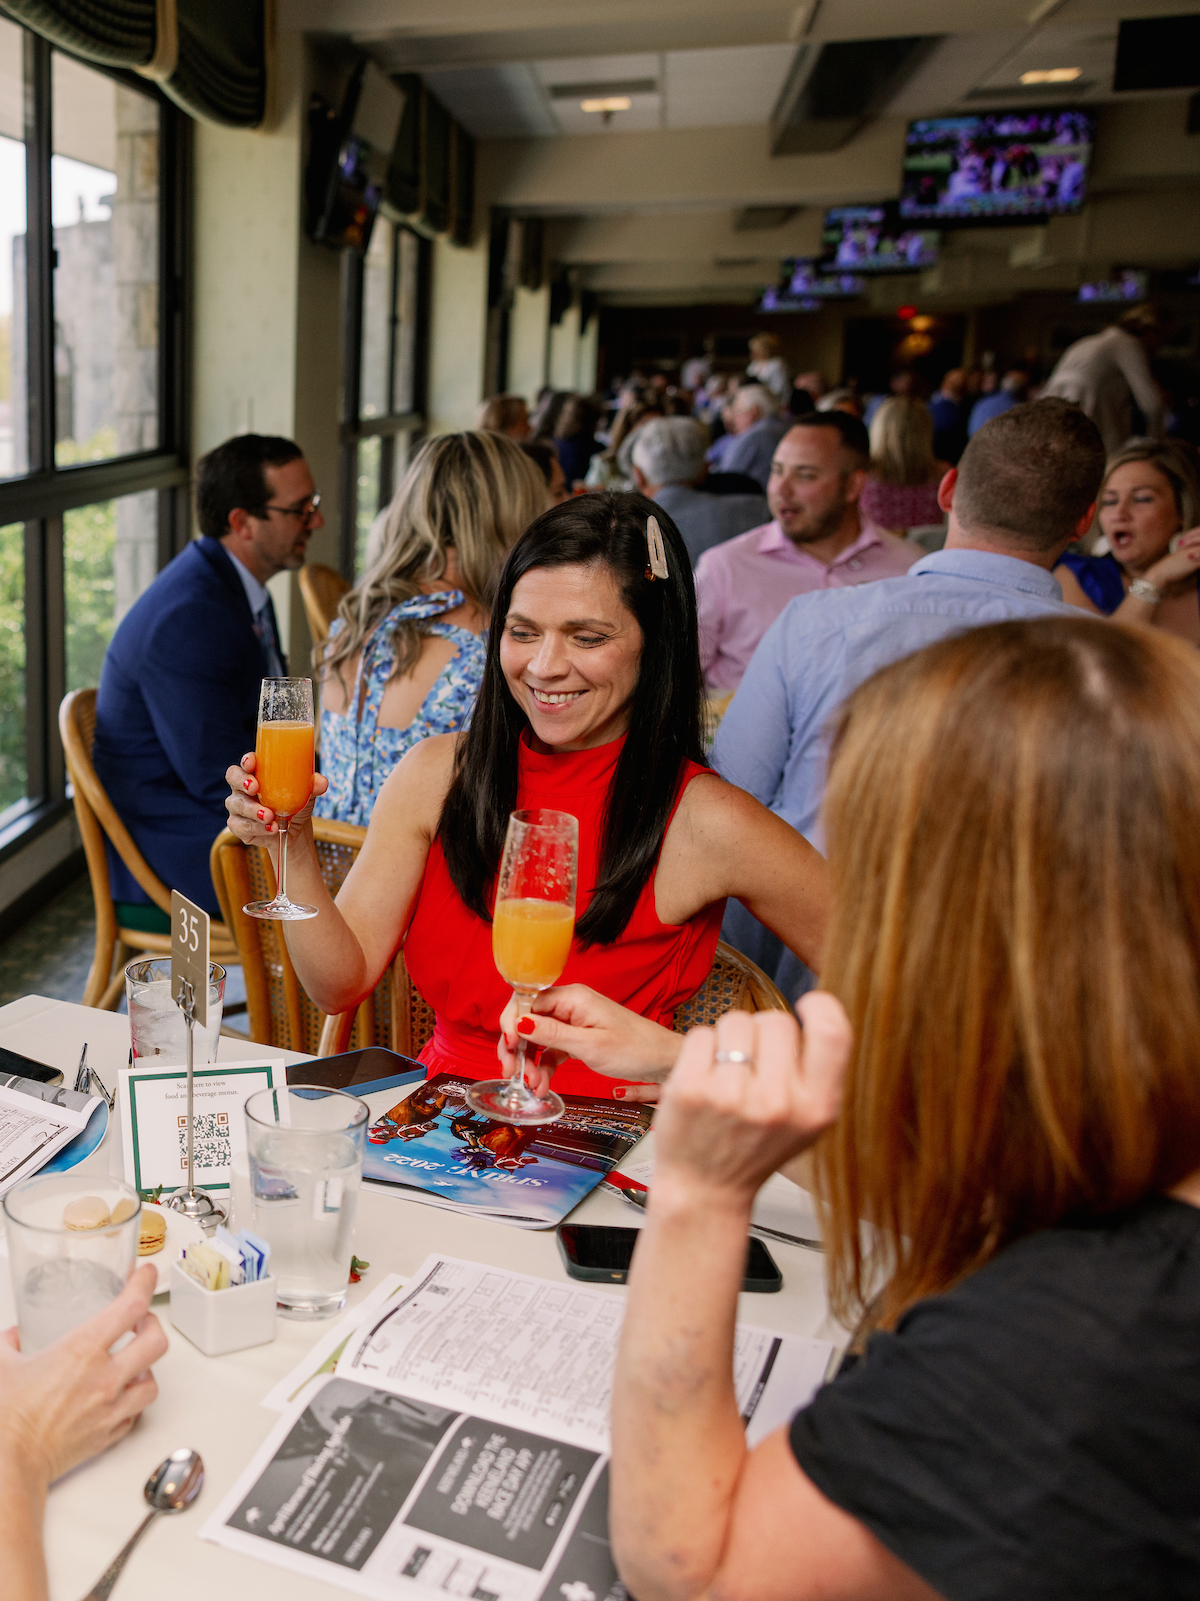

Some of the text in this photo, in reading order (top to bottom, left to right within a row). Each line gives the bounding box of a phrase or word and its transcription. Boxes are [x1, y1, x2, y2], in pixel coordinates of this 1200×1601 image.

[179, 908, 199, 951] 35
[382, 1153, 549, 1187] SPRING 2022
[450, 1450, 496, 1515] DOWNLOAD
[487, 1487, 515, 1521] RACE
